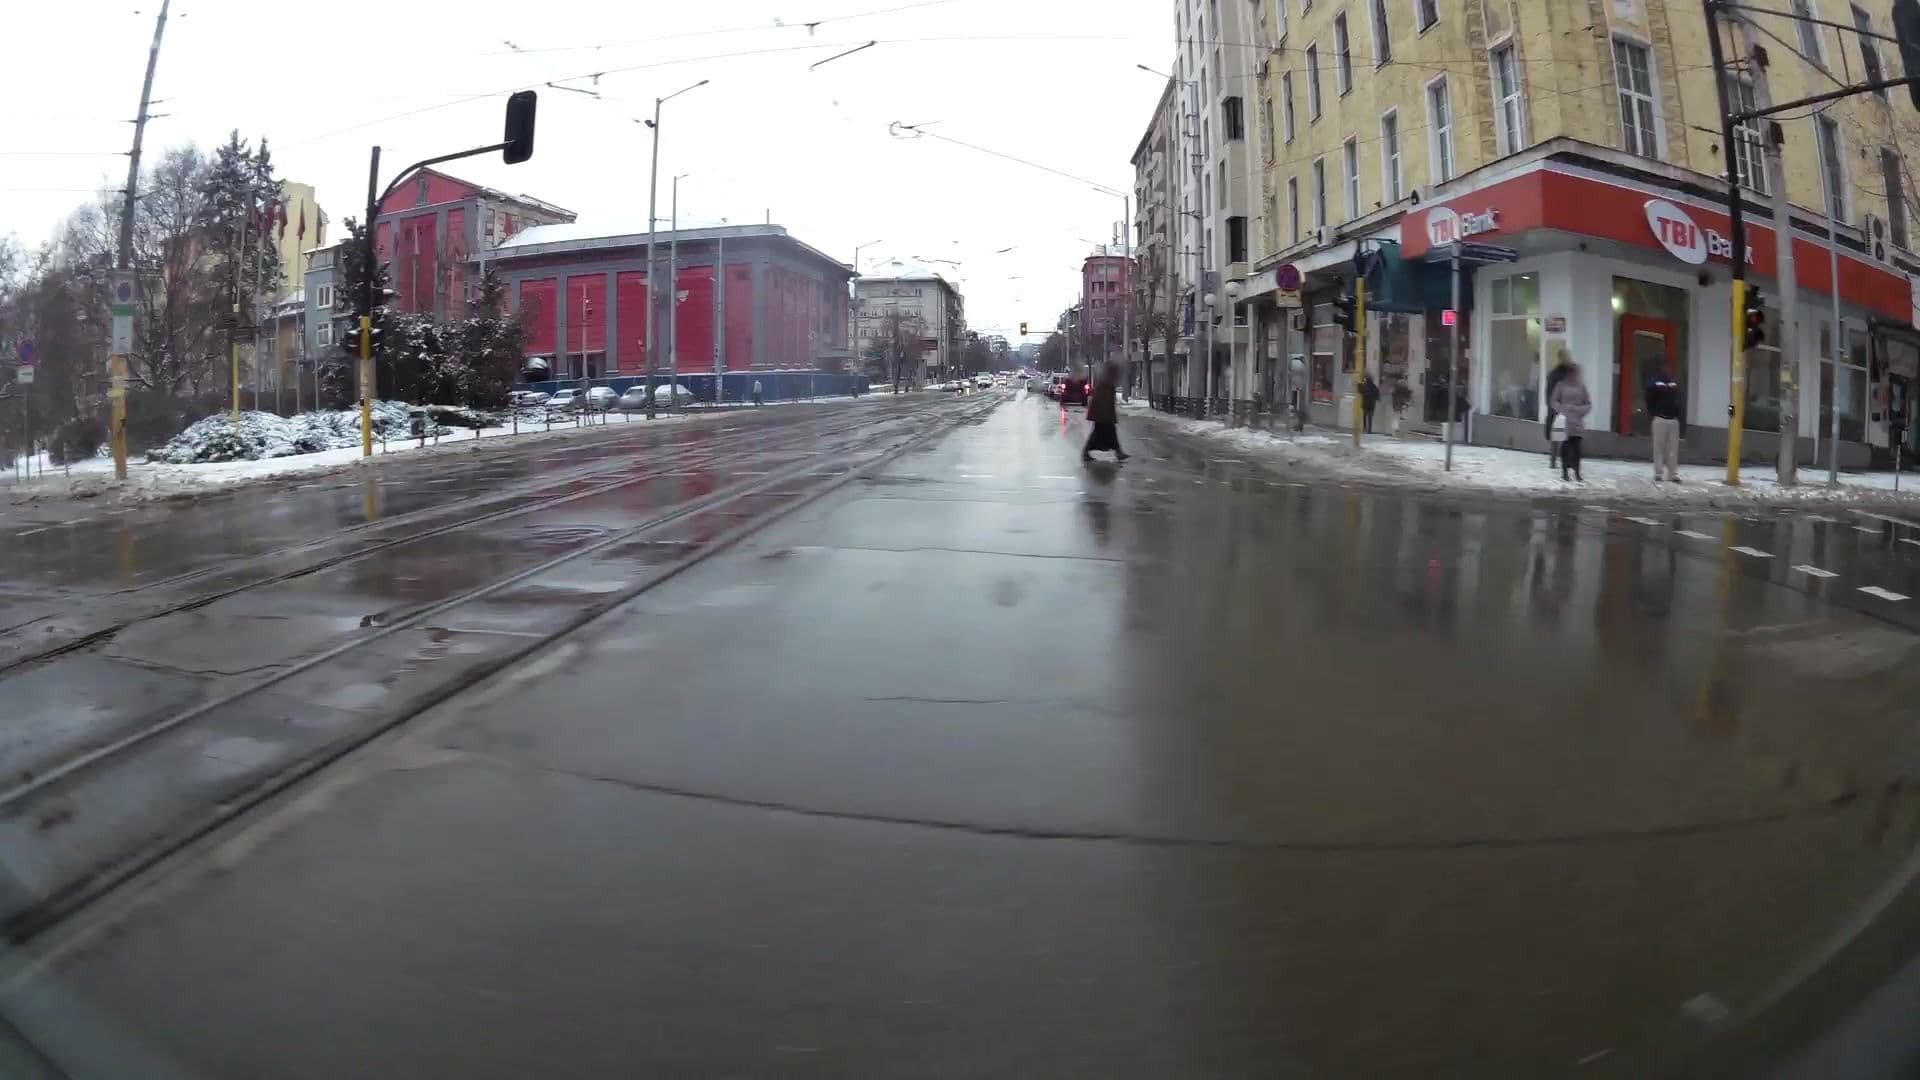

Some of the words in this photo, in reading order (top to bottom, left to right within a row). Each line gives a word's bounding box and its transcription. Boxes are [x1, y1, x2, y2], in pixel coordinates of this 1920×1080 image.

[1461, 208, 1500, 238] Bank
[1656, 215, 1697, 250] TBI
[1704, 228, 1754, 265] Bak
